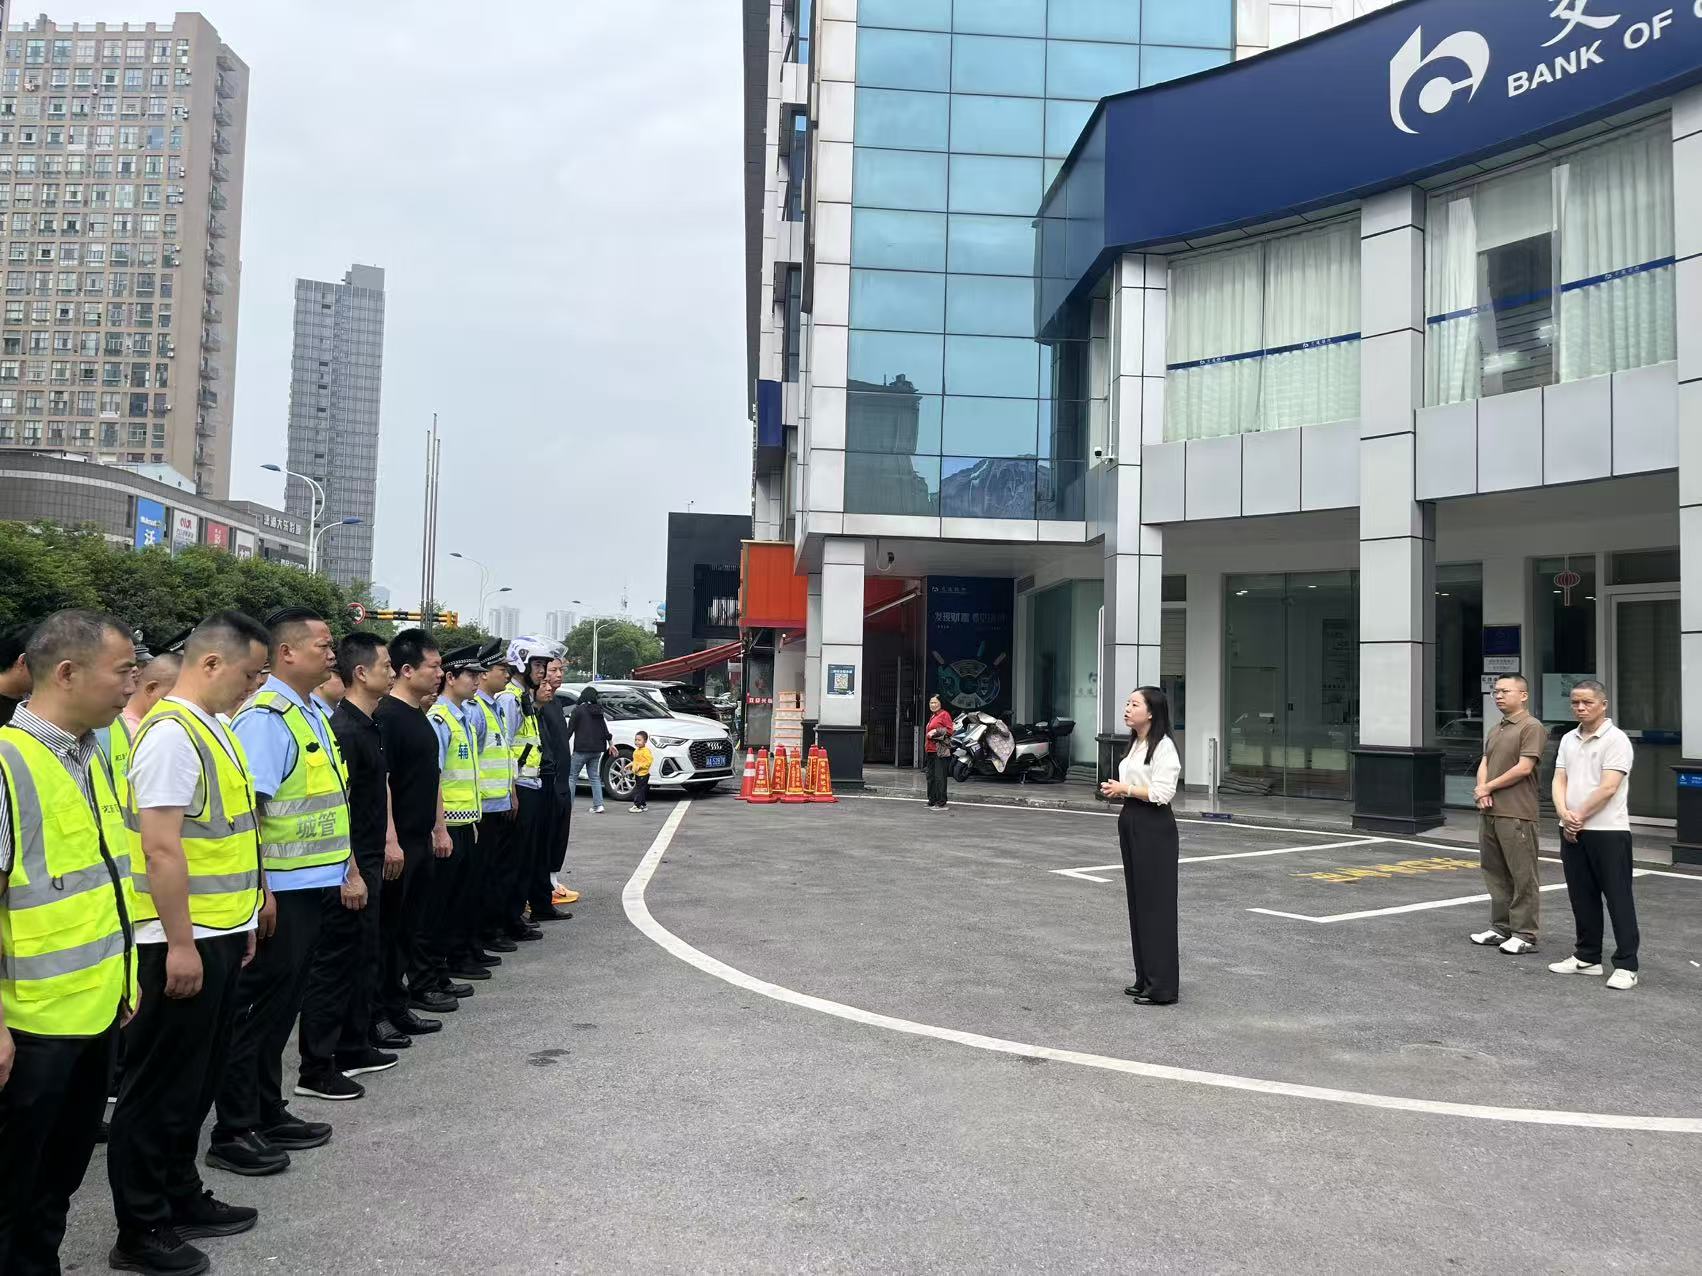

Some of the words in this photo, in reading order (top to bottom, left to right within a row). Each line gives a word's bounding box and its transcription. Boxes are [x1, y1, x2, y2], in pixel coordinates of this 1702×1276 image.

[1507, 39, 1605, 97] BANK
[1623, 8, 1673, 50] OF
[296, 811, 337, 838] 城管
